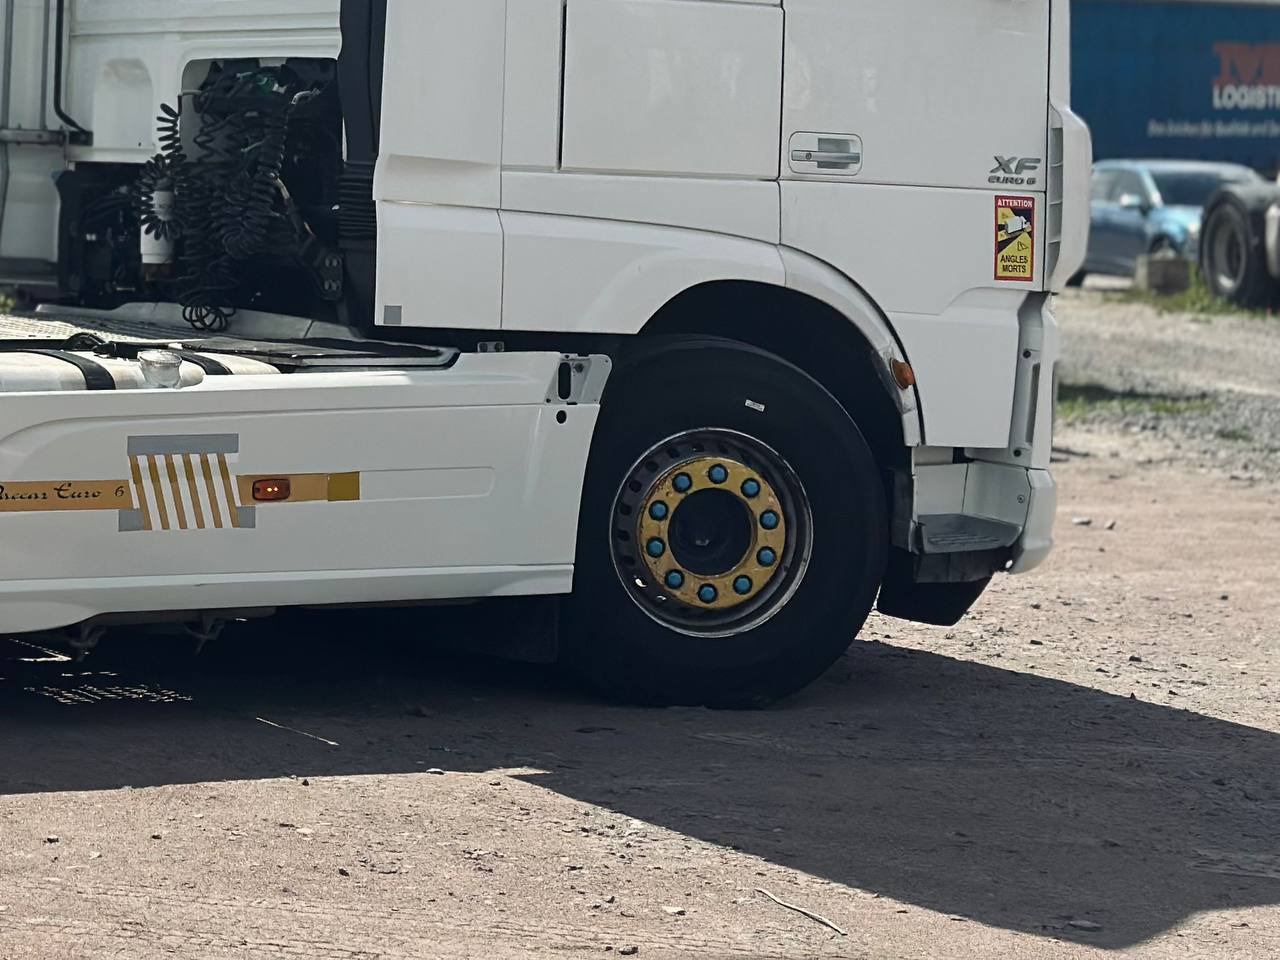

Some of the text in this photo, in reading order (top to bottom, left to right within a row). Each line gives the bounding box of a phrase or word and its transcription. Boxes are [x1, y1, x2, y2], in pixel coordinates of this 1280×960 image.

[989, 155, 1042, 175] XF
[987, 175, 1024, 185] EURO
[997, 198, 1032, 208] ATTENTION
[1000, 255, 1028, 264] ANGLES
[1002, 264, 1027, 273] MORTS
[53, 482, 102, 500] Euro
[114, 486, 125, 498] 6
